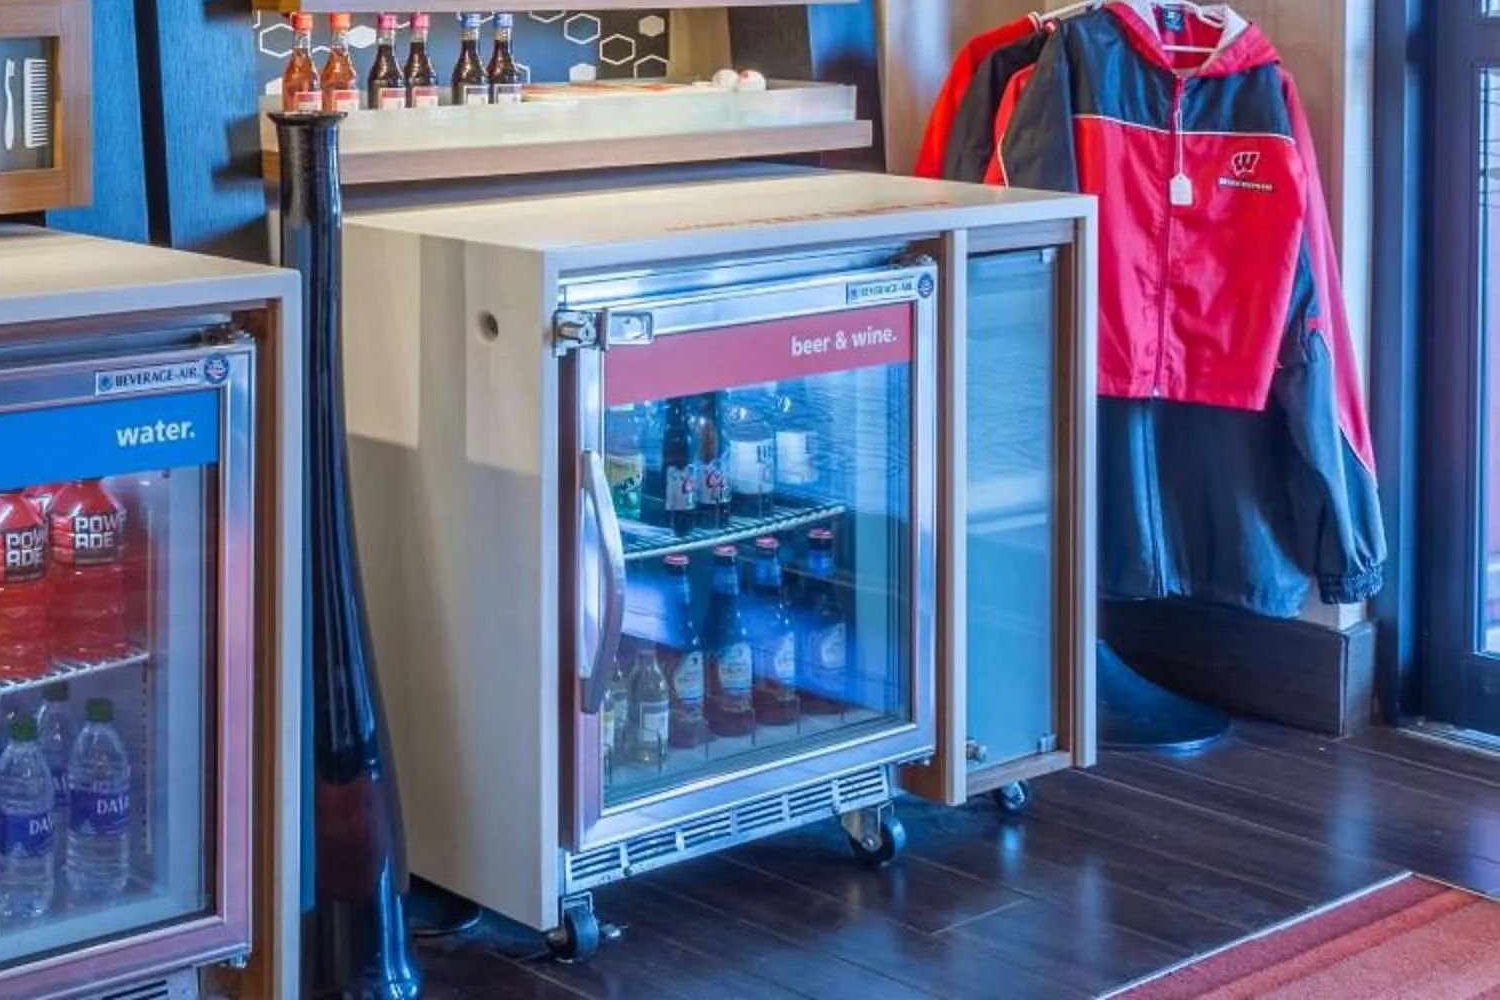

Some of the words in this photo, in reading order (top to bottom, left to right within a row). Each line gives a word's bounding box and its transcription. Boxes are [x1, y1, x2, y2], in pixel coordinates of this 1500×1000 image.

[791, 333, 830, 358] beer
[835, 330, 848, 350] &
[852, 325, 898, 349] wine.
[116, 418, 196, 449] water.
[76, 530, 115, 549] ADE
